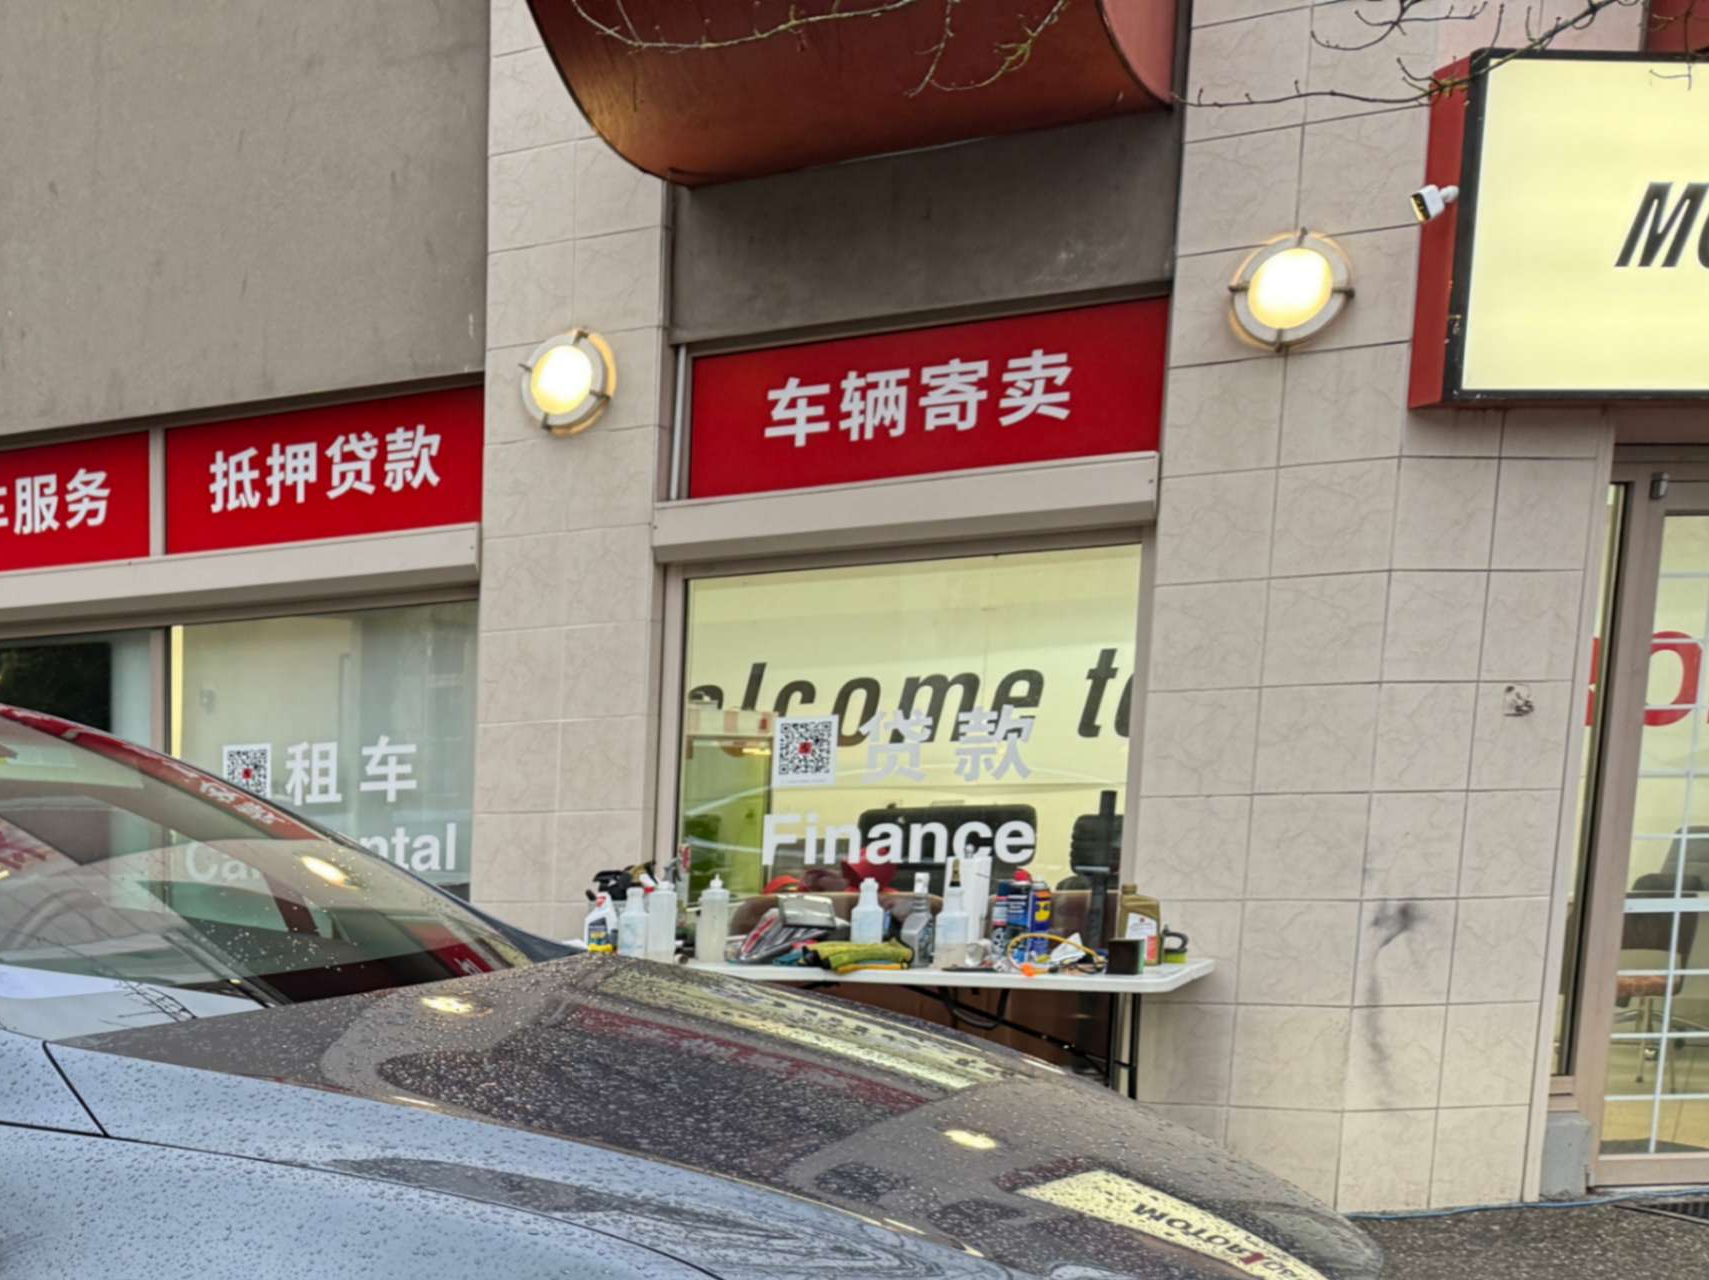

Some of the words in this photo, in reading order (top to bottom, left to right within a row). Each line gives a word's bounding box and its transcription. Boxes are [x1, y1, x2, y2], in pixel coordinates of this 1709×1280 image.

[1614, 181, 1709, 268] M
[763, 348, 1073, 447] 车辆寄卖
[209, 425, 441, 514] 抵押贷款
[285, 735, 417, 806] 租车
[859, 704, 1036, 783] 贷款
[762, 813, 1037, 866] Finance
